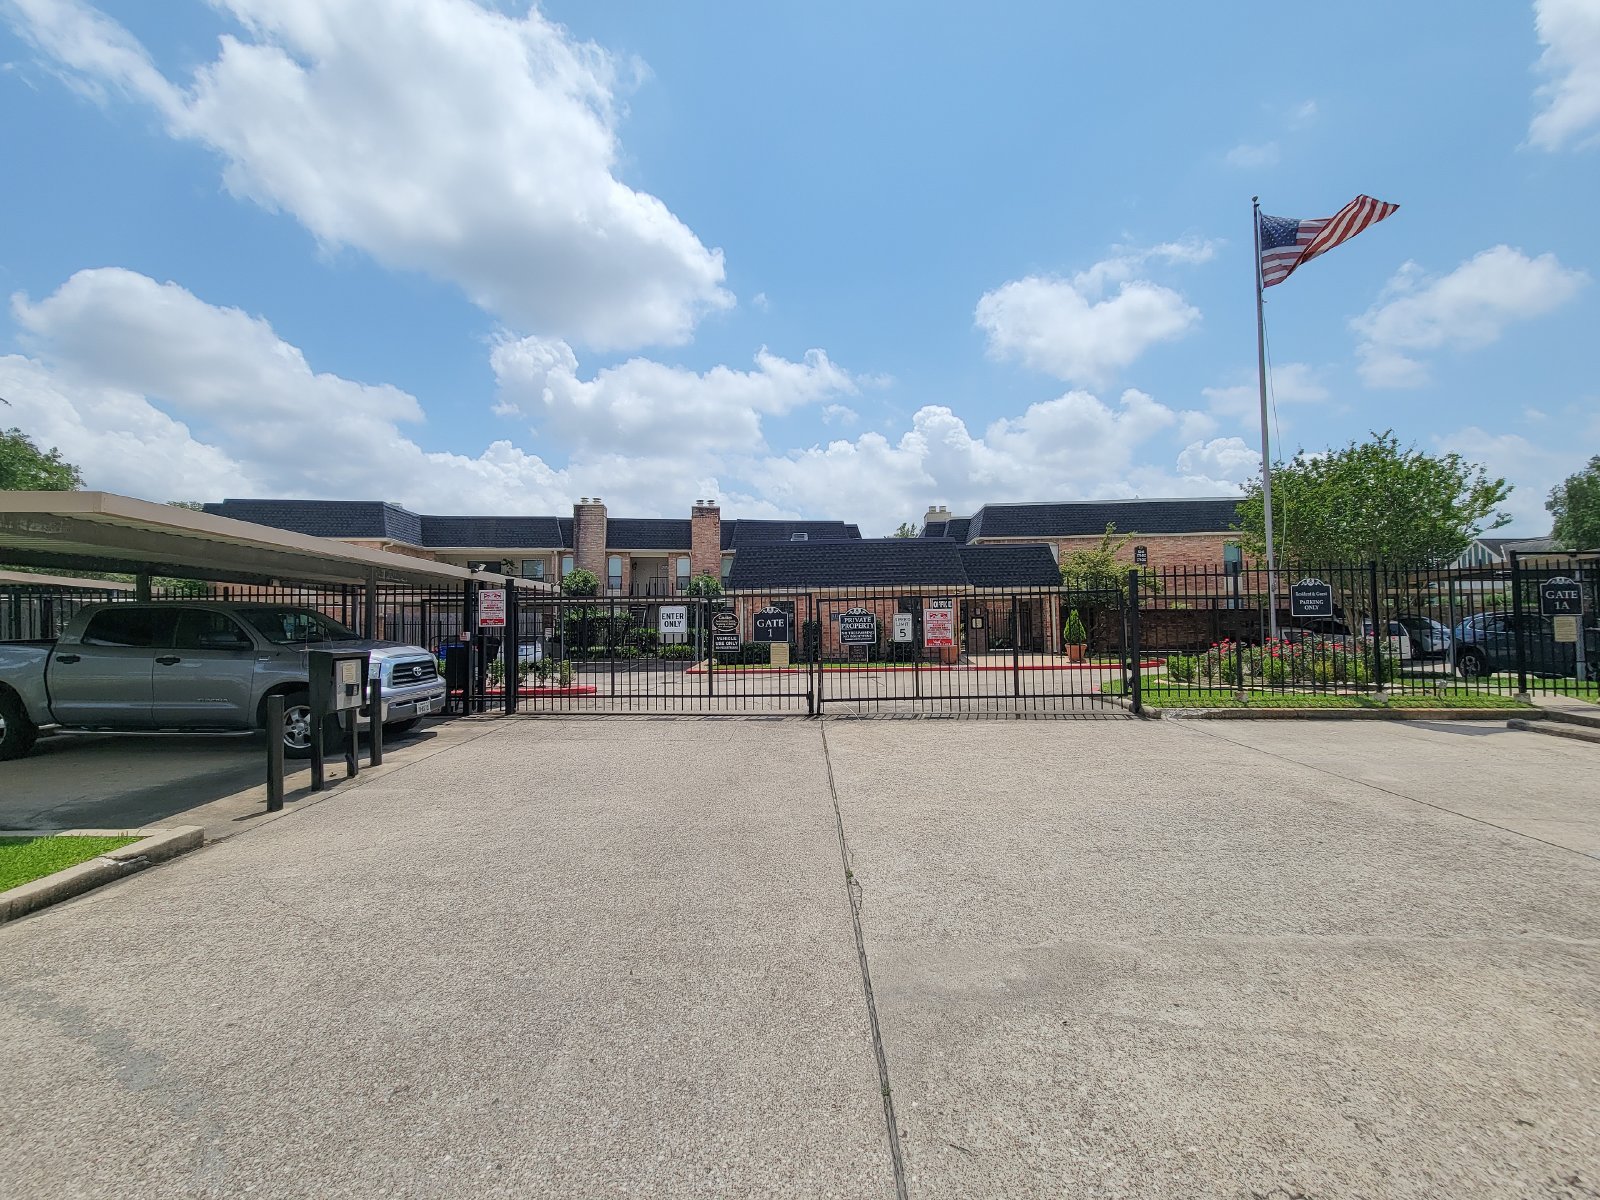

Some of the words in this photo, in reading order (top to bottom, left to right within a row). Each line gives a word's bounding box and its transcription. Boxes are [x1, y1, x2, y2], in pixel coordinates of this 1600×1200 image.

[1545, 590, 1578, 598] GATE
[1554, 602, 1570, 610] 1A
[756, 619, 784, 628] GATE
[768, 629, 772, 638] 1
[900, 628, 906, 638] 5
